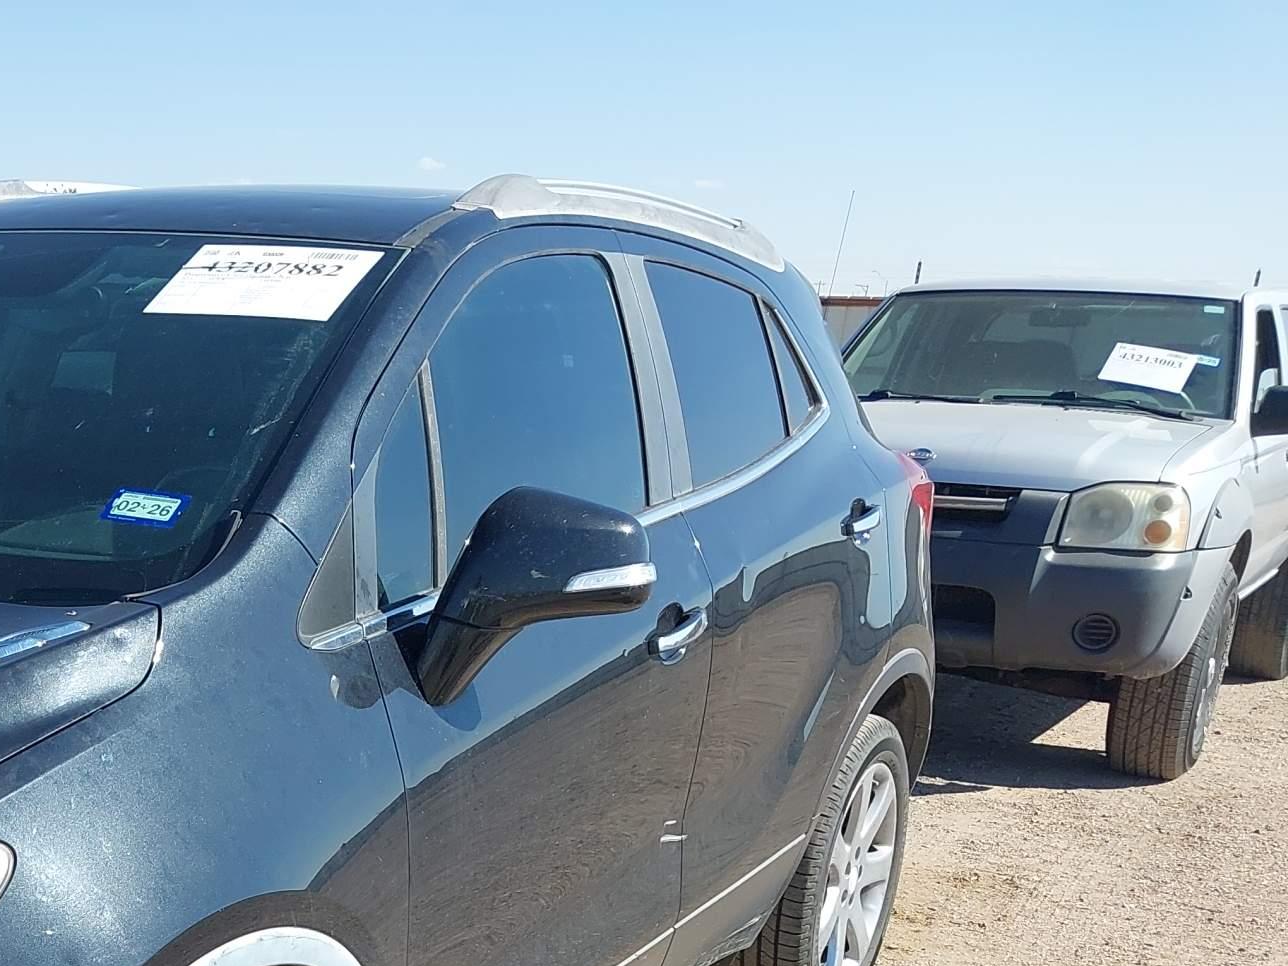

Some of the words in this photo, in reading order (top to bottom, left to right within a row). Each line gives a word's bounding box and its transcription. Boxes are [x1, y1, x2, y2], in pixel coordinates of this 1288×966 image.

[206, 260, 345, 277] 43207882
[117, 500, 141, 513] 02
[146, 503, 173, 517] 26
